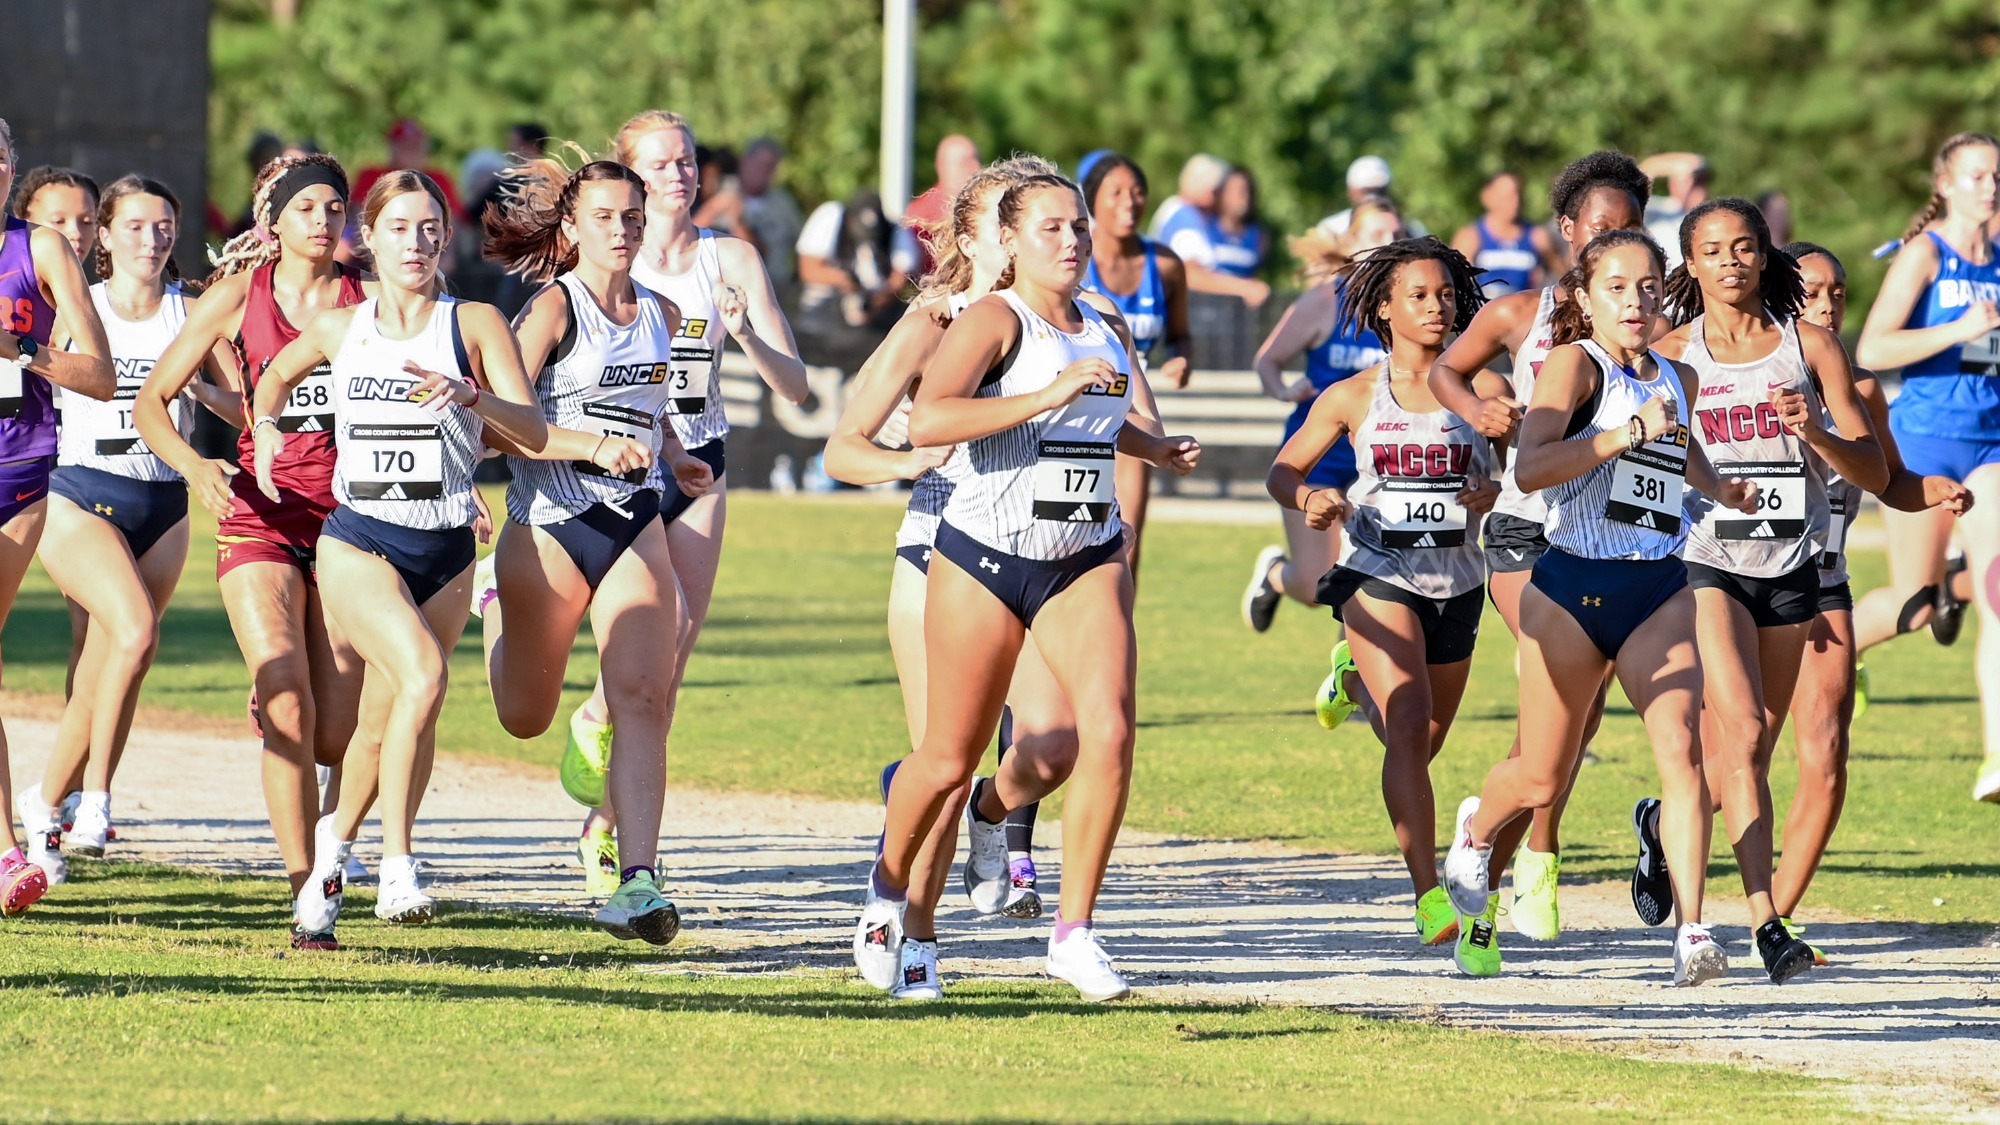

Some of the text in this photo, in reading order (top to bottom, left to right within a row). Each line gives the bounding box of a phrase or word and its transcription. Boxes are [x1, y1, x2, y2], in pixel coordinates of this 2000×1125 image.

[599, 363, 668, 387] UNCG
[1699, 384, 1735, 397] MEAC
[587, 407, 651, 425] CROSS COUNTRY CHALLENGE
[1696, 402, 1798, 446] NCC
[1375, 422, 1410, 432] MEAC
[1044, 446, 1065, 454] CROSS
[1370, 444, 1472, 477] NCCU
[1624, 450, 1683, 471] CROSS COUNTRY CHALLENGE
[372, 451, 415, 473] 170
[1718, 467, 1740, 475] CROSS
[1768, 466, 1801, 474] CHALLENGE
[1064, 469, 1101, 493] 177
[1386, 481, 1406, 489] CROSS
[1632, 474, 1665, 504] 381
[1405, 502, 1446, 523] 140
